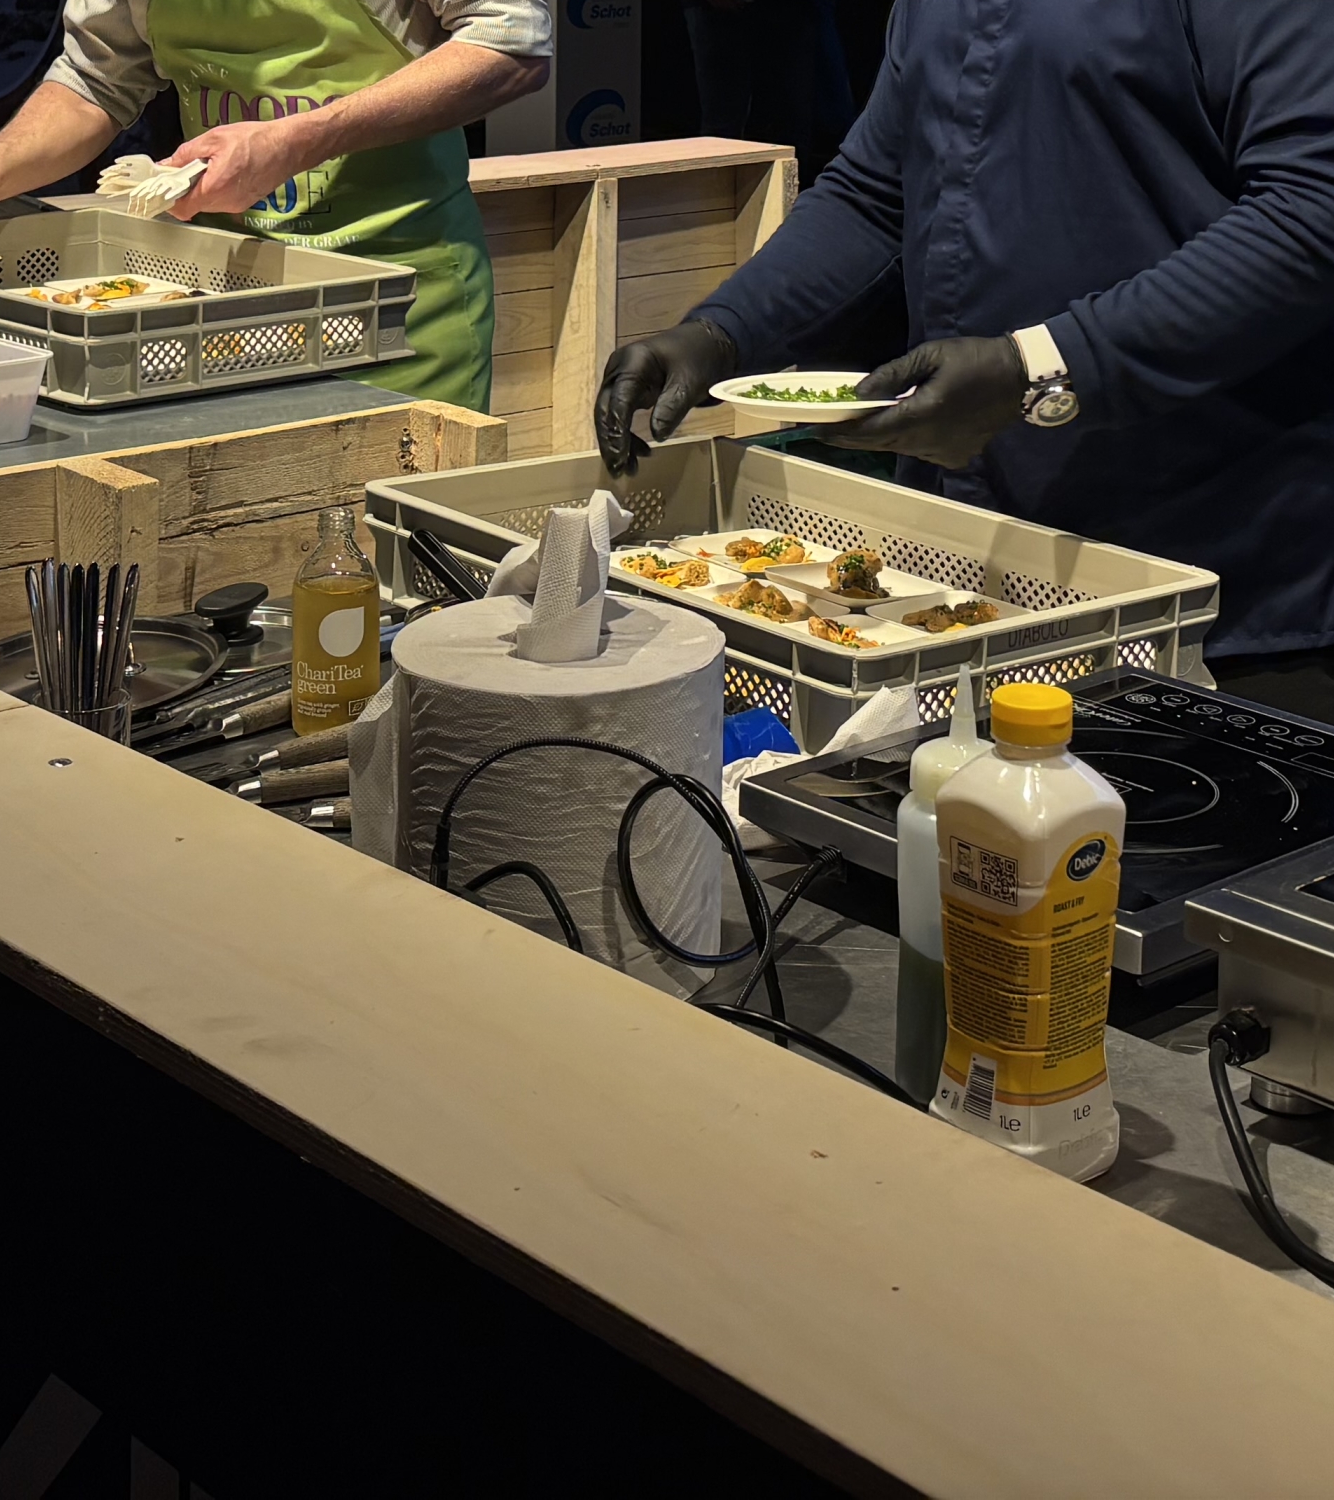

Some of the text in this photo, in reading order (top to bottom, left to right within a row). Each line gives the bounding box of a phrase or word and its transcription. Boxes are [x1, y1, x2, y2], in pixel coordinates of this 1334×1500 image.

[590, 4, 632, 19] Schot
[589, 121, 631, 138] Schot
[1008, 619, 1069, 648] DIABOLO
[297, 661, 363, 681] ChariTea
[297, 678, 337, 695] green
